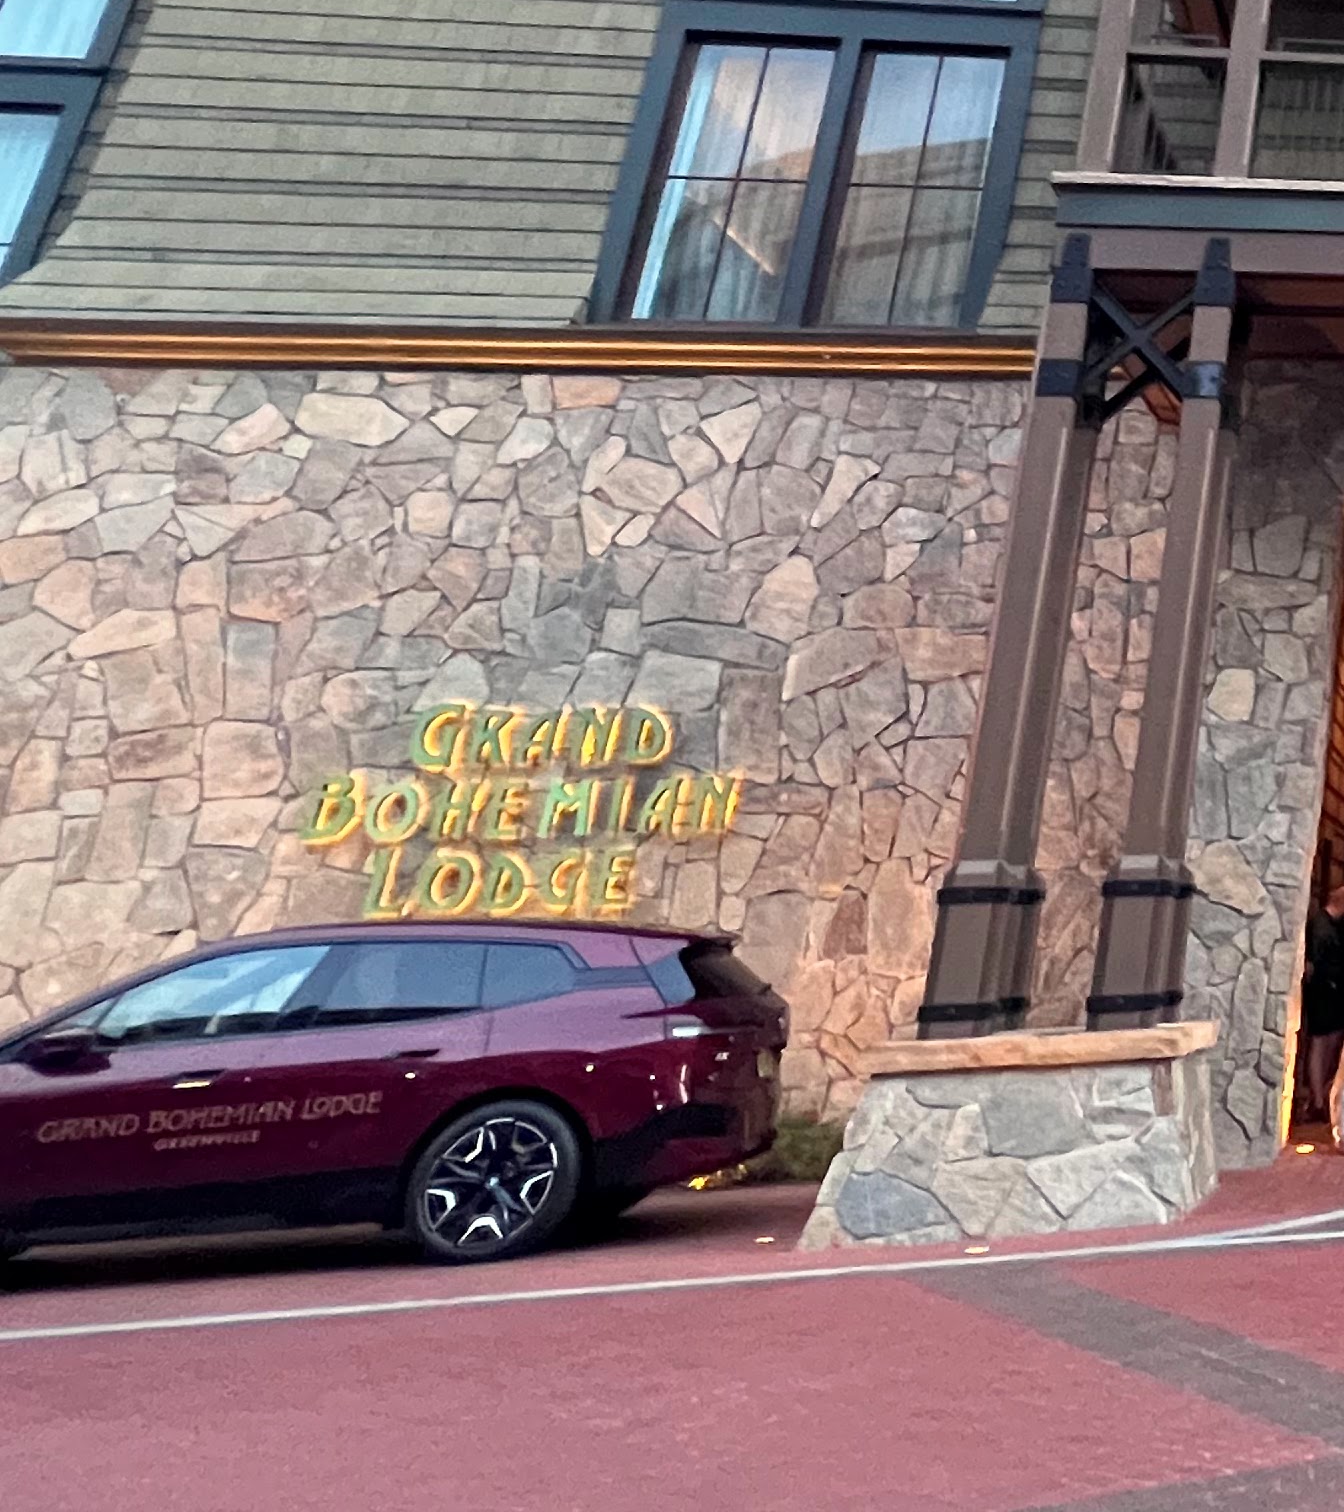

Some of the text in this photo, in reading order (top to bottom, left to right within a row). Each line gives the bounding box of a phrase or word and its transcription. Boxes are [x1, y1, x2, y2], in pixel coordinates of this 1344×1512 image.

[412, 702, 672, 773] GRAND
[301, 770, 743, 846] BOHEMIAN
[364, 846, 637, 918] LODGE
[37, 1090, 384, 1143] GRAND BOHEMIAN LODGE
